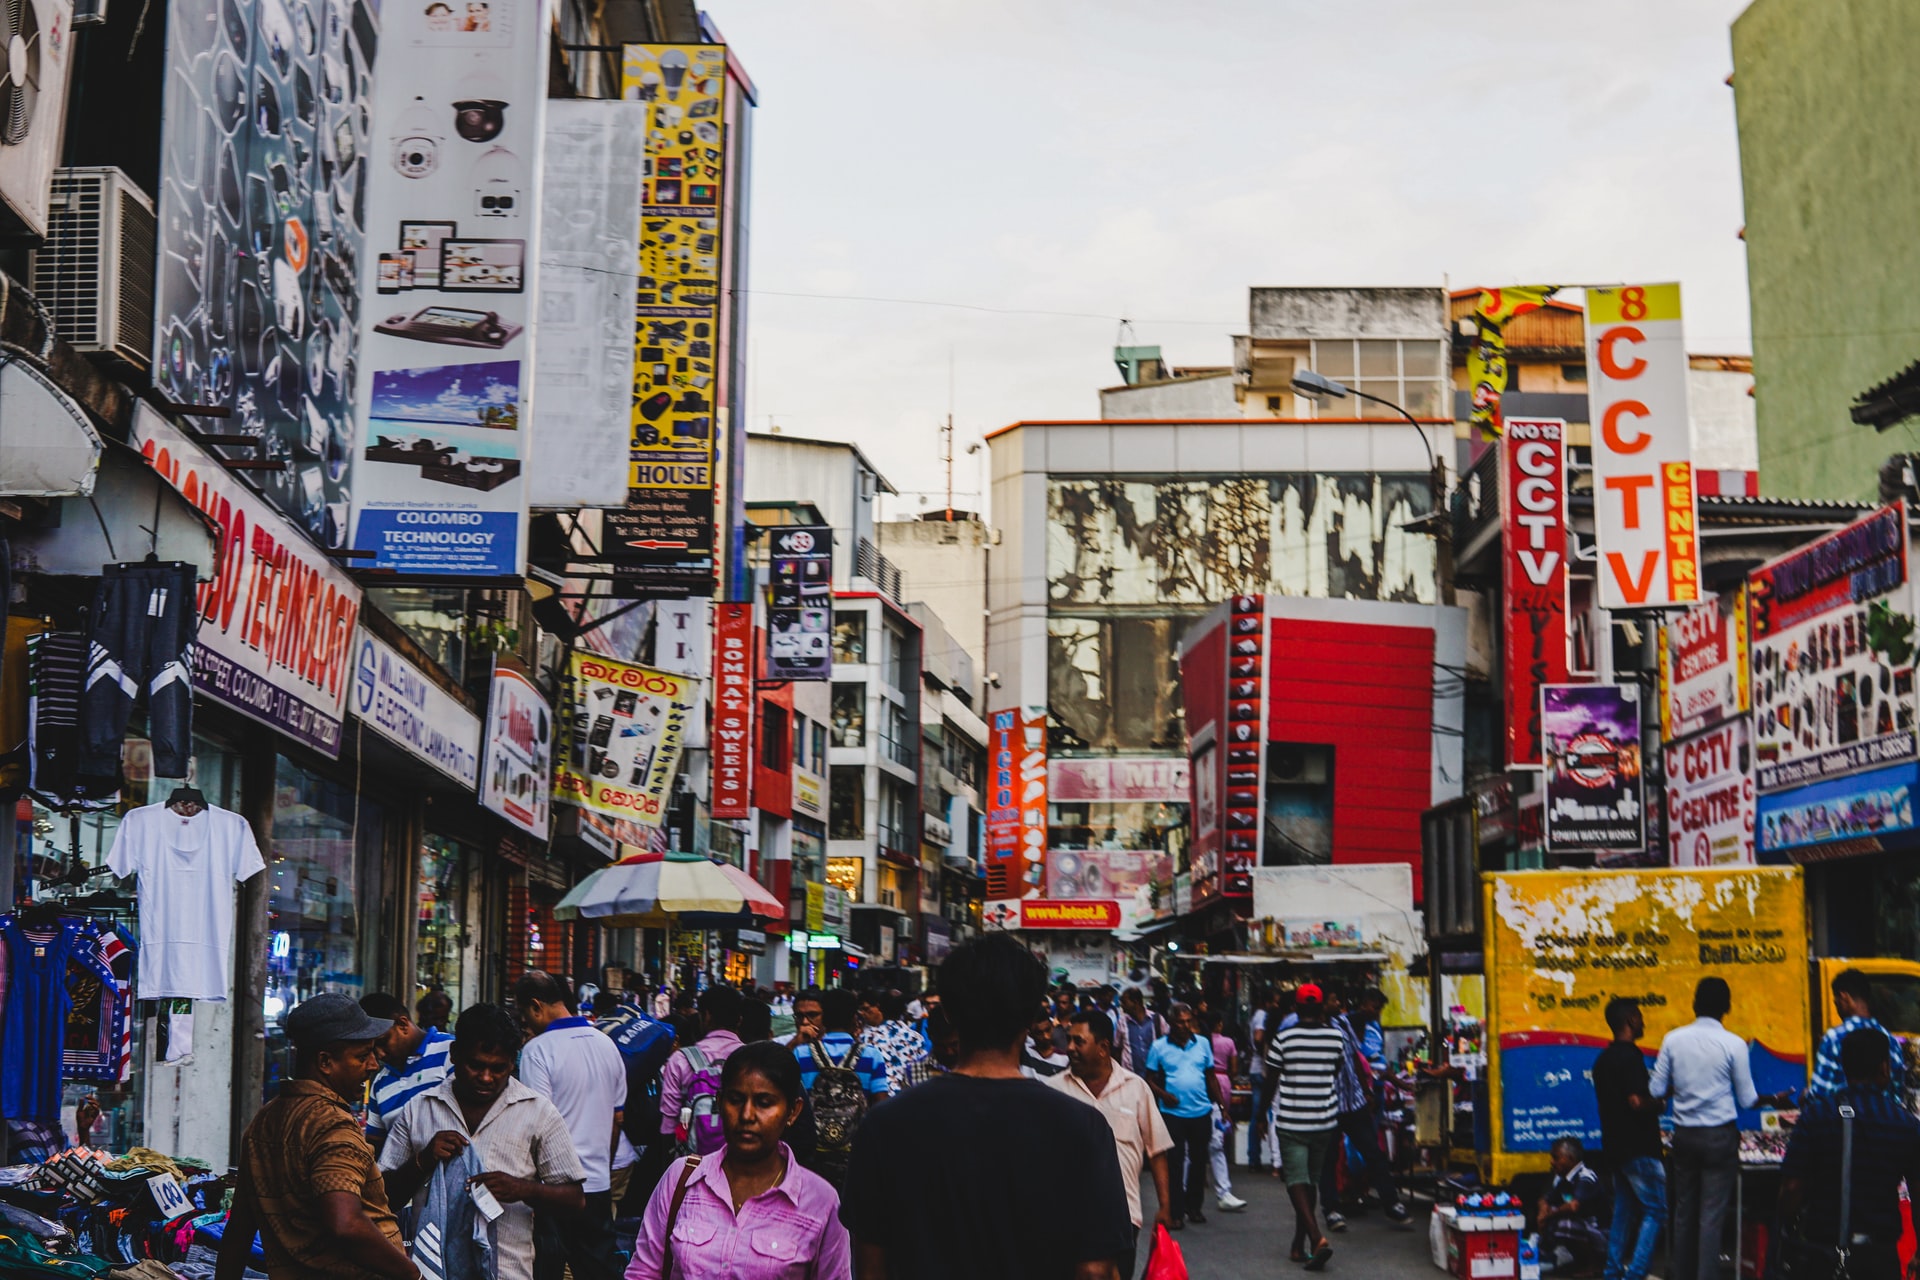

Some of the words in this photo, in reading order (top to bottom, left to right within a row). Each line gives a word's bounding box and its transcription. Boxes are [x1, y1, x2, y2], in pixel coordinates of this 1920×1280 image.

[1621, 286, 1648, 321] 8
[1511, 423, 1540, 440] NO
[637, 465, 708, 485] HOUSE
[1597, 325, 1660, 604] CCTV
[382, 531, 495, 545] TECHNOLOGY
[396, 511, 483, 525] COLOMBO
[1516, 441, 1560, 586] CCTV
[1665, 462, 1697, 602] CENTRE
[241, 524, 358, 711] TECHNOLOGY
[232, 668, 274, 713] COLOMBO
[580, 661, 679, 696] කැමරා
[722, 638, 744, 711] BOMBAY
[650, 701, 694, 794] WHOLESALE
[718, 718, 745, 790] SWEETS
[995, 711, 1014, 807] MICRO
[1684, 727, 1732, 784] CCTV
[1681, 785, 1739, 833] CENTRE
[156, 1181, 183, 1211] 100
